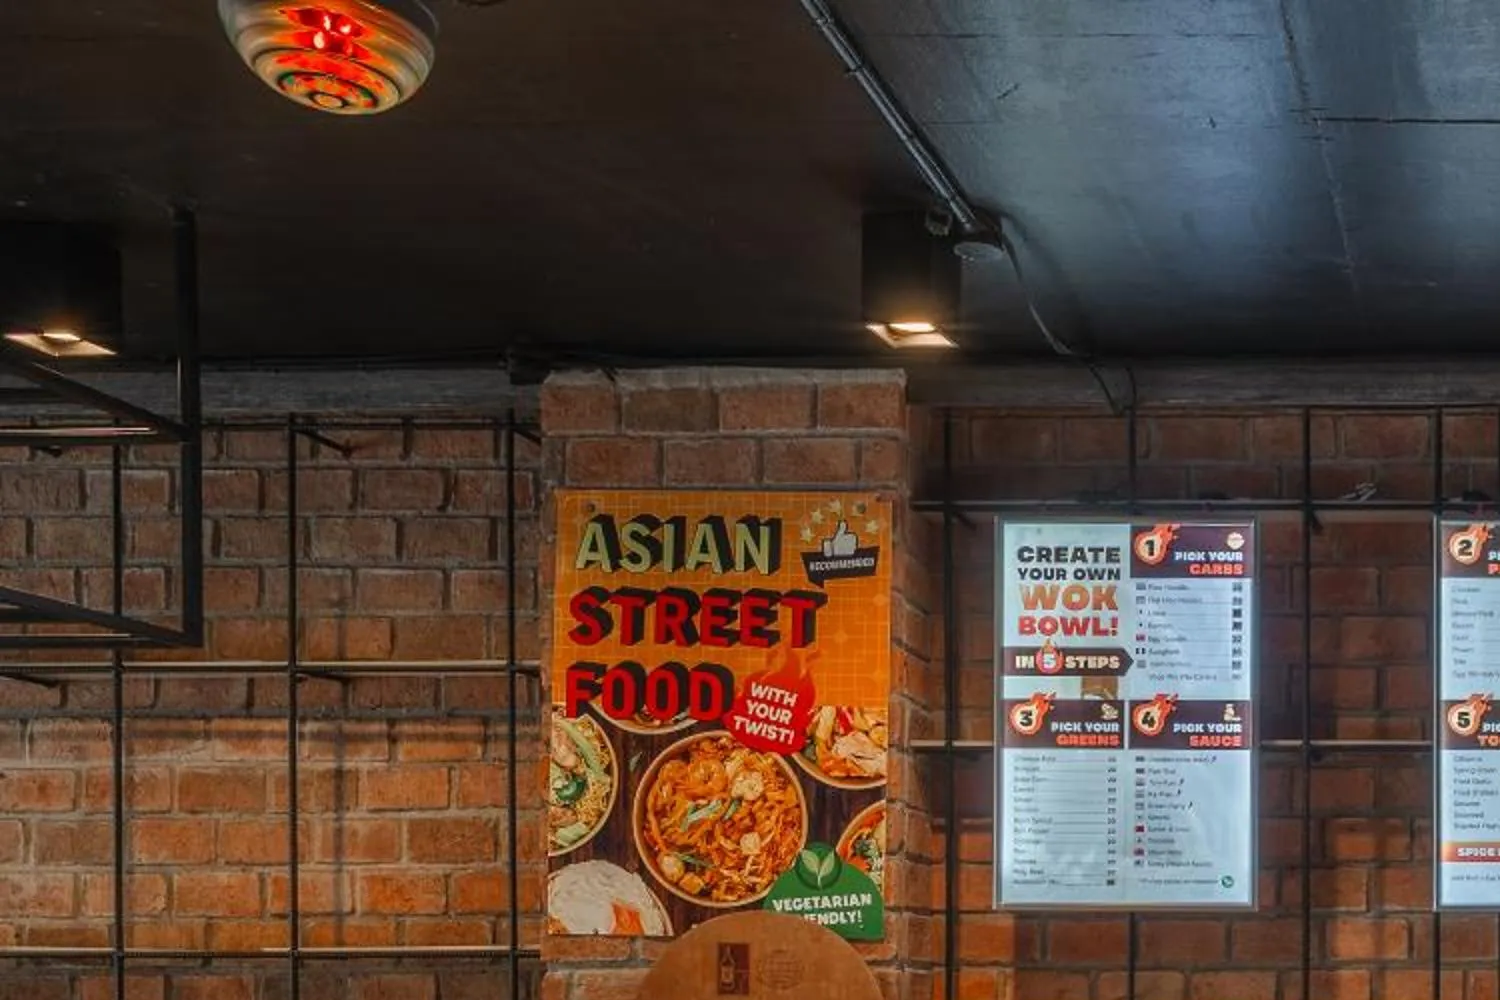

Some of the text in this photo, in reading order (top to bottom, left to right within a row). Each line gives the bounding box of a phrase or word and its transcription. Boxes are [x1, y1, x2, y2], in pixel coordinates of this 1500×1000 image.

[575, 515, 780, 575] ASIAN
[1144, 539, 1156, 556] 1
[1457, 540, 1473, 556] 2
[1017, 546, 1121, 564] CREATE
[1175, 551, 1243, 561] PICK YOUR
[809, 557, 875, 571] RECOMMENDED
[1189, 564, 1243, 575] CARBS
[1017, 567, 1121, 580] YOUR OWN
[1019, 585, 1118, 611] WOK
[568, 587, 826, 648] STREET
[1017, 616, 1119, 637] BOWL!
[1015, 653, 1120, 669] IN 5 STEPS
[565, 662, 733, 721] FOOD
[751, 682, 798, 707] WITH
[746, 700, 793, 724] YOUR
[1019, 711, 1033, 727] 3
[1141, 711, 1156, 728] 4
[1457, 711, 1471, 728] 5
[733, 715, 795, 745] TWIST!
[1051, 721, 1120, 732] PICK YOUR
[1173, 723, 1242, 733] PICK YOUR
[1055, 734, 1120, 746] GREENS
[1189, 735, 1242, 747] SAUCE
[1457, 847, 1494, 857] SPICE
[772, 893, 872, 911] VEGETARIAN
